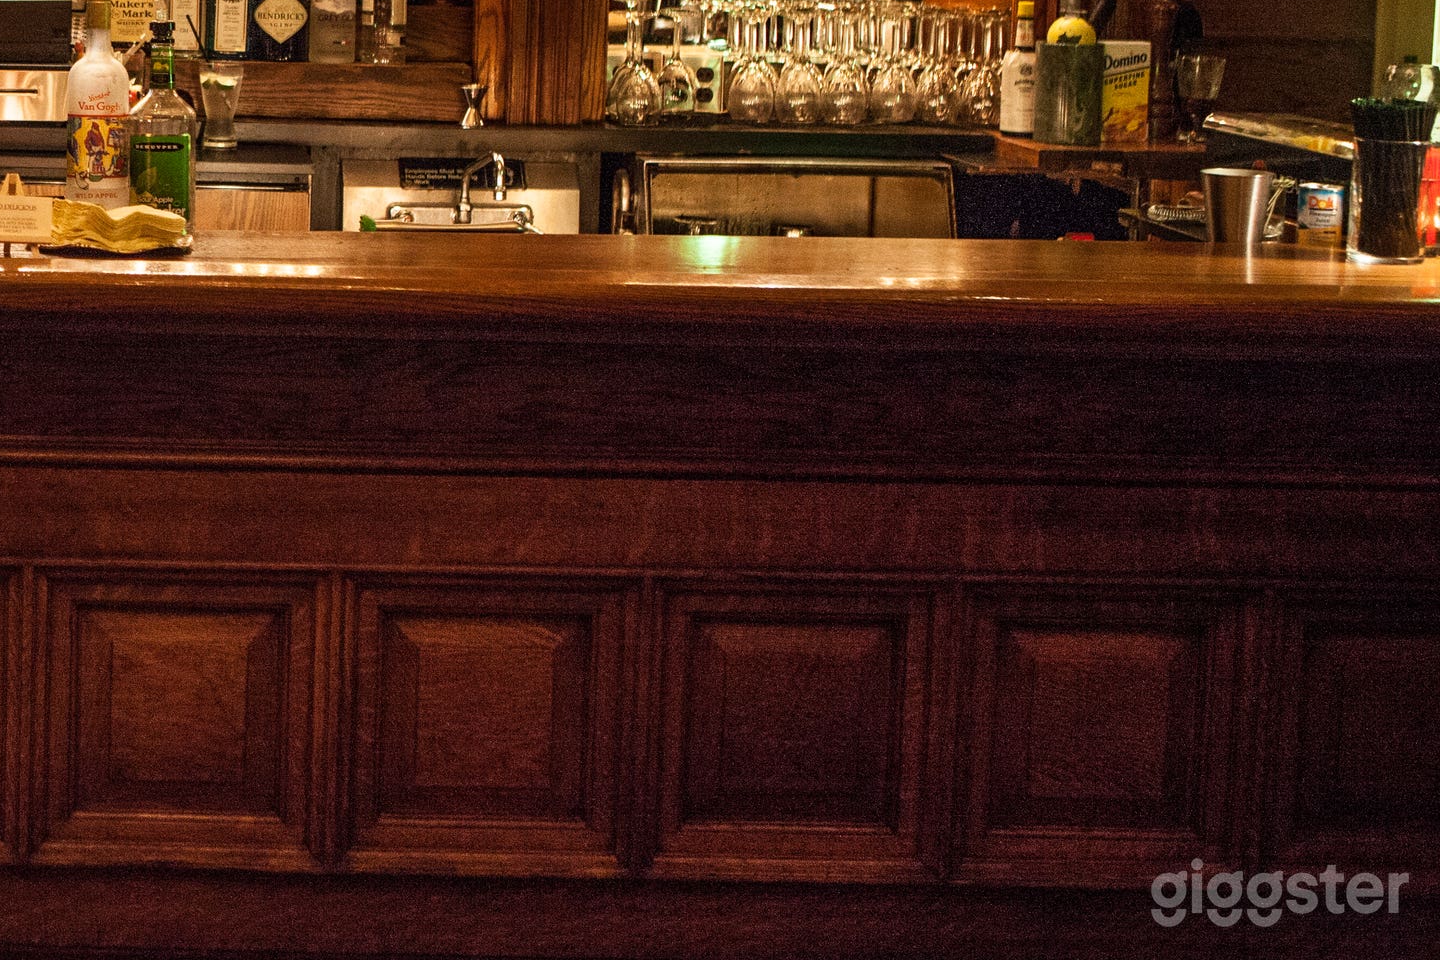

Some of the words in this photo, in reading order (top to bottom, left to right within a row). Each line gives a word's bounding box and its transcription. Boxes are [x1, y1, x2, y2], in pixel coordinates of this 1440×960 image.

[110, 0, 154, 9] Maker's
[122, 9, 153, 18] Mark
[257, 12, 305, 21] HENDRICK'S
[1104, 52, 1148, 71] Domino
[1104, 70, 1145, 86] SUPERFINE
[78, 101, 95, 111] Van
[97, 102, 120, 113] Gogh
[154, 196, 173, 204] Apple
[4, 203, 37, 211] DELICIOUS
